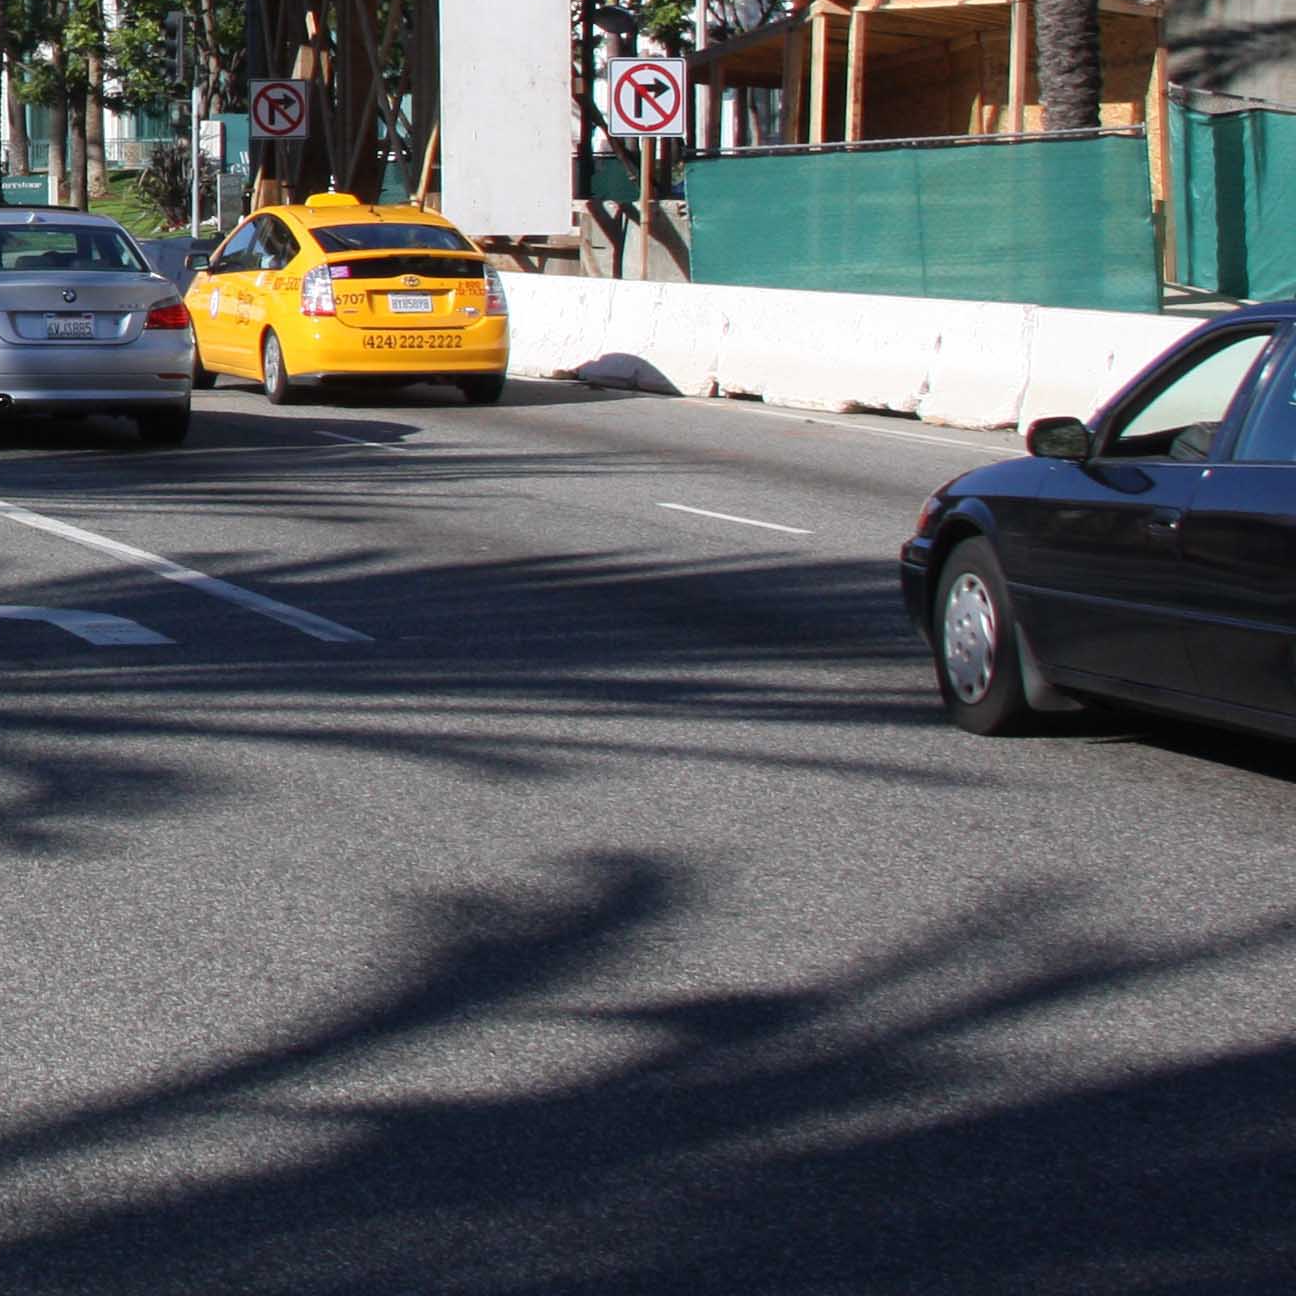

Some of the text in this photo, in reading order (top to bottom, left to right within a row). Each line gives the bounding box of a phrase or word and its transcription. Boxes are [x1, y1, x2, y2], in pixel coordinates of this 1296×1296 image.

[335, 292, 365, 305] 6707
[362, 335, 463, 350] (424) 222-2222
